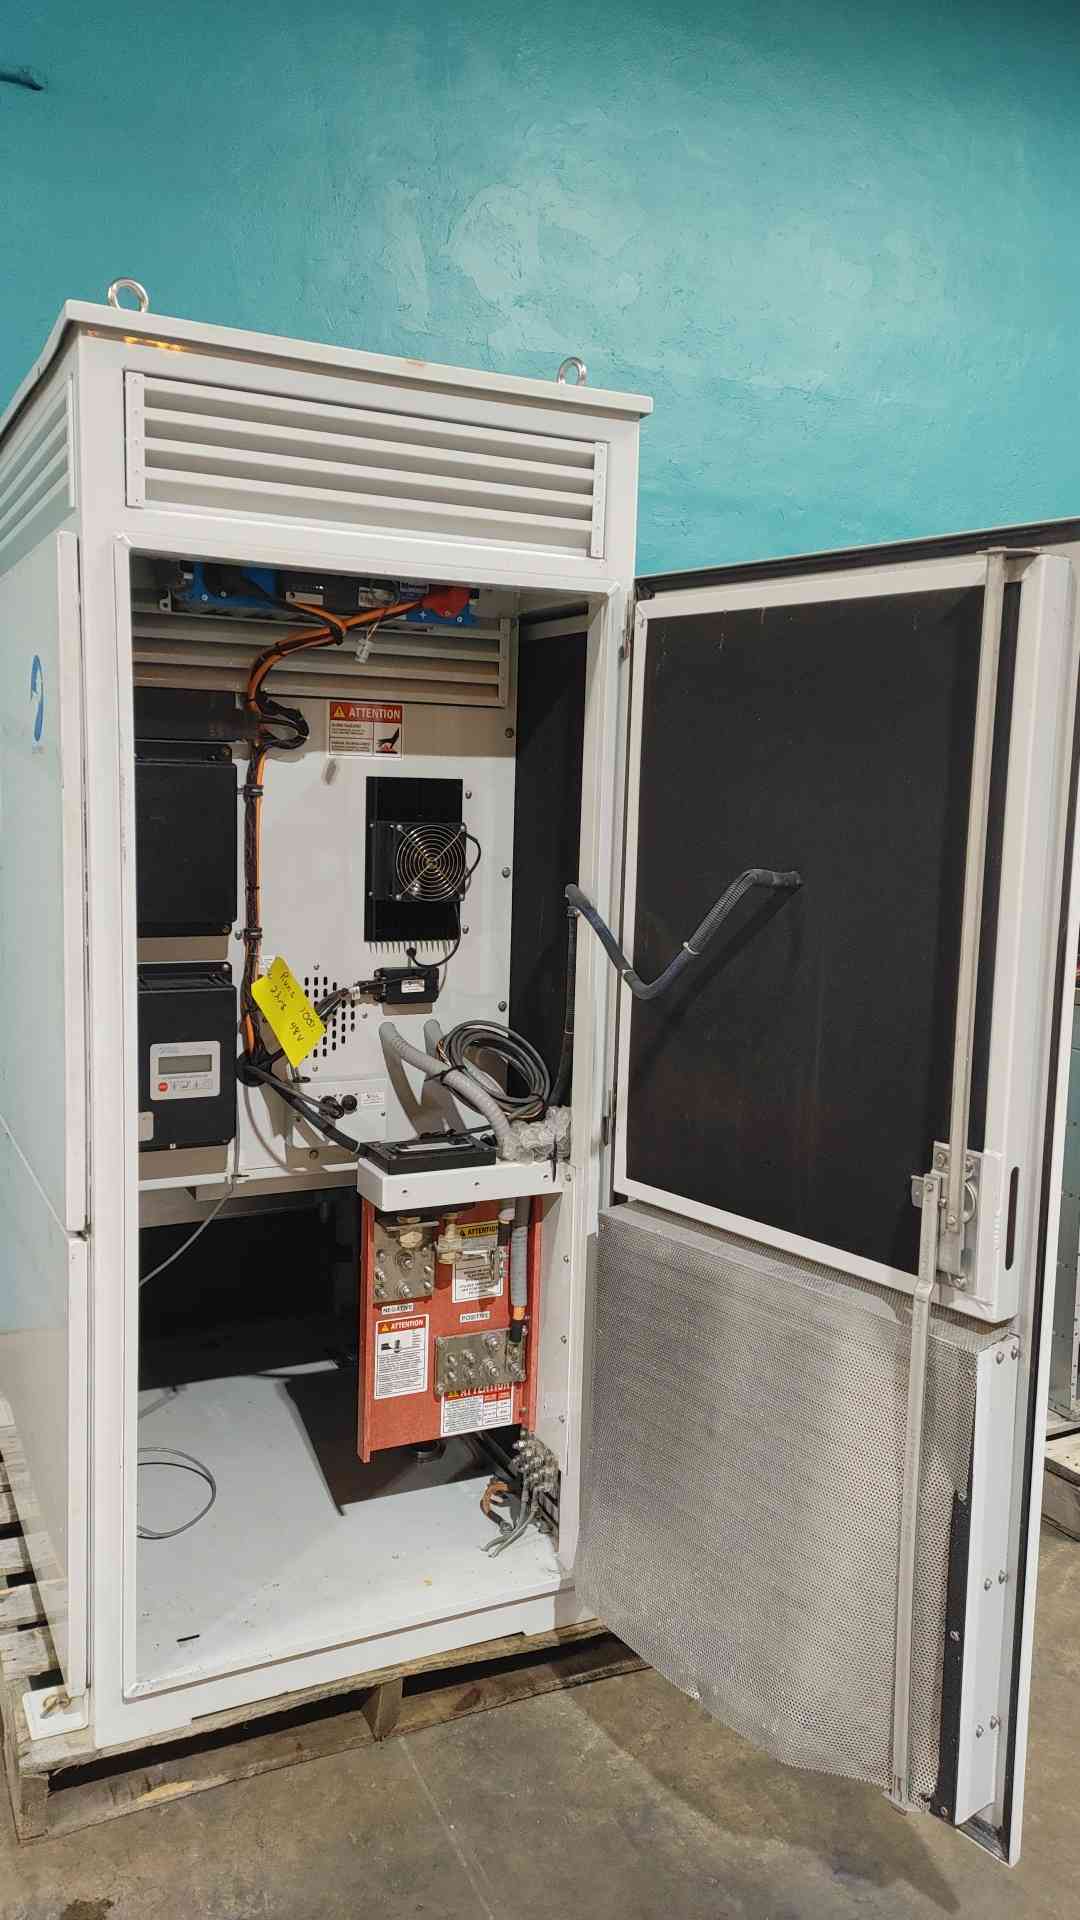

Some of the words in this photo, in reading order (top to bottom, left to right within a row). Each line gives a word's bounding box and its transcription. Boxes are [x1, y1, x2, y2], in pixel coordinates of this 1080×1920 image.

[348, 706, 401, 721] ATTENTION
[383, 1303, 413, 1313] NEGATIVE
[461, 1311, 490, 1321] POSITIVE
[391, 1319, 424, 1330] ATTENTION
